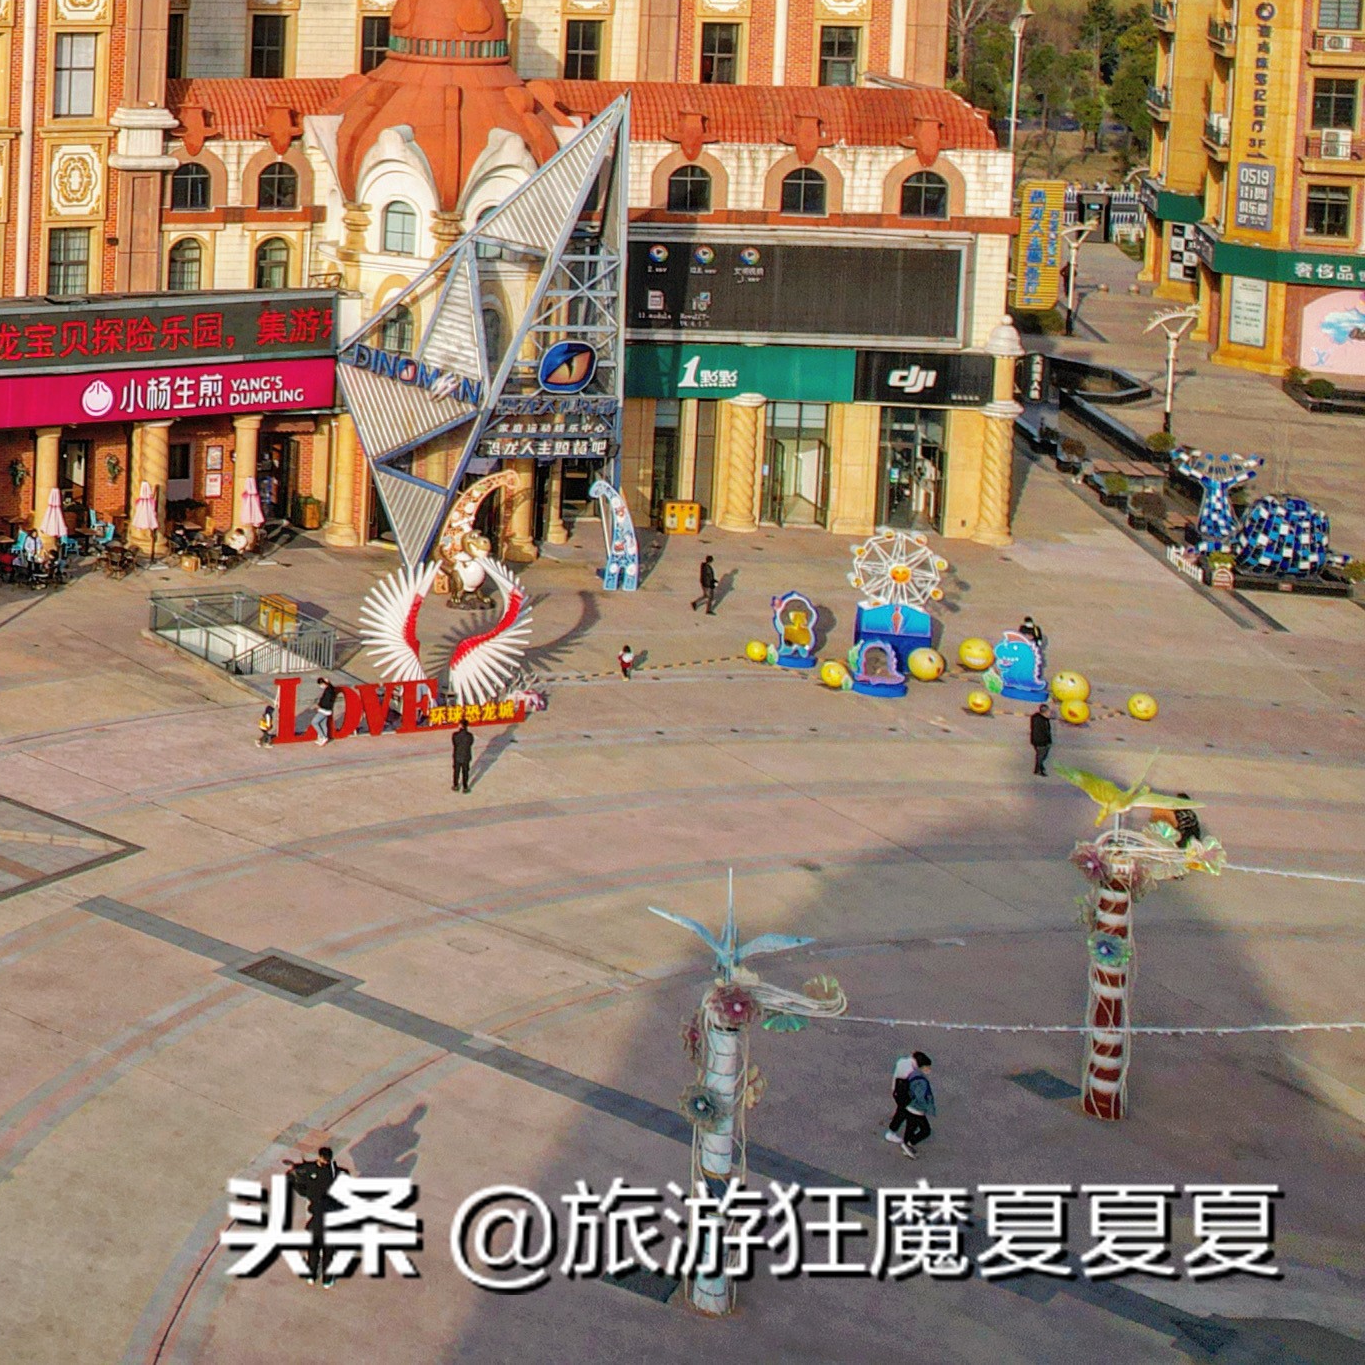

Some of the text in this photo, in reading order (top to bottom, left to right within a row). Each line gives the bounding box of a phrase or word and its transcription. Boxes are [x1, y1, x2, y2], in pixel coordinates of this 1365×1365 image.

[1240, 167, 1270, 185] 0519
[119, 373, 284, 413] 小杨生煎 YANG'S
[228, 388, 305, 407] DUMPLING
[272, 677, 438, 744] LOVE
[427, 700, 516, 726] 环球恐龙城
